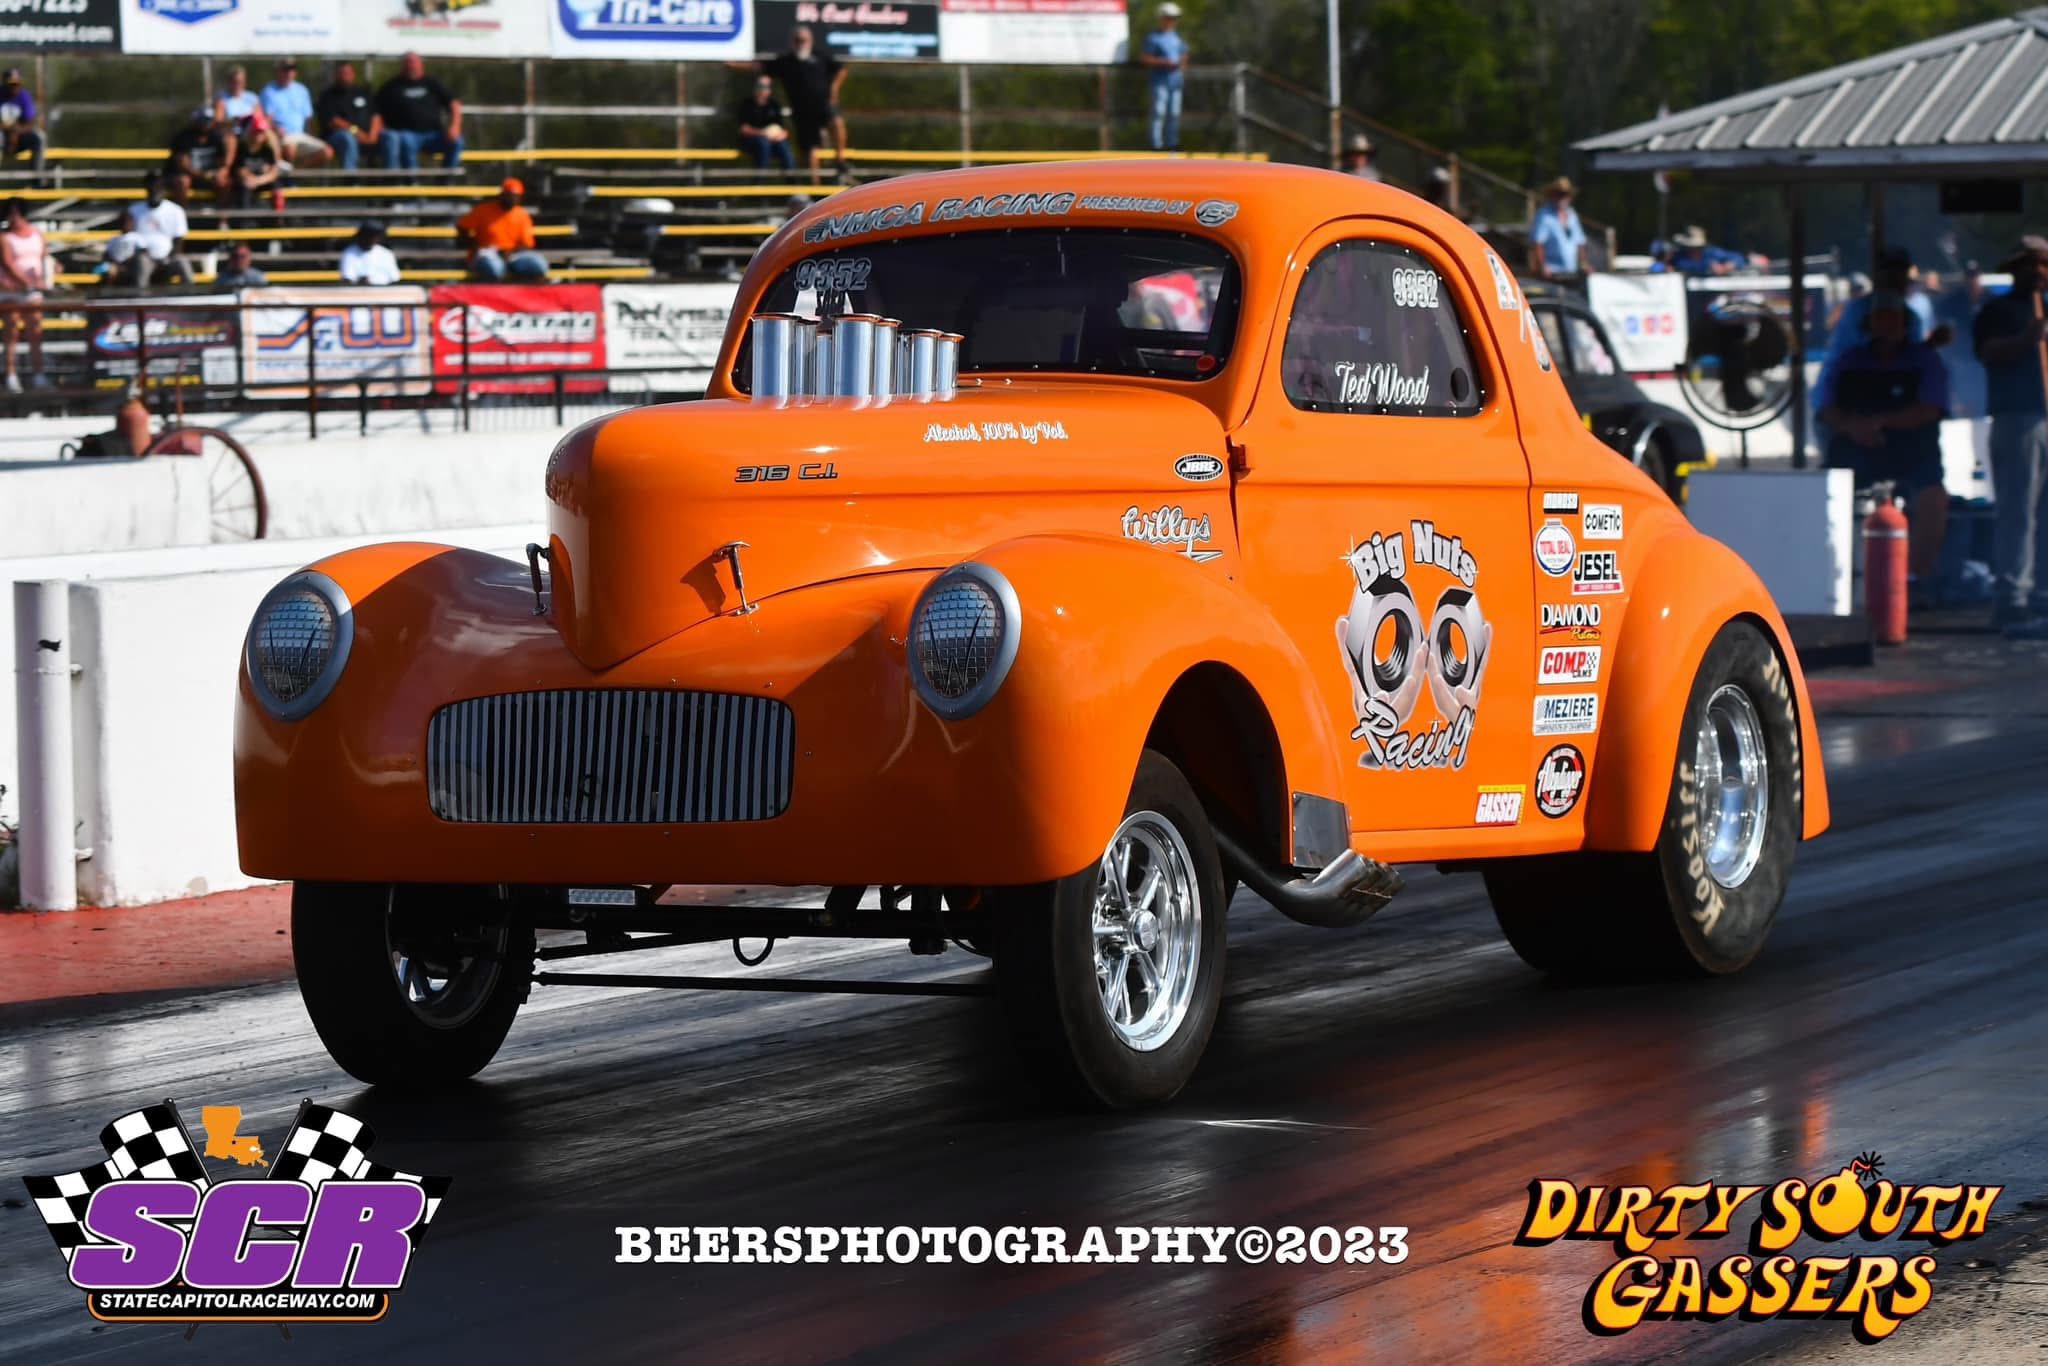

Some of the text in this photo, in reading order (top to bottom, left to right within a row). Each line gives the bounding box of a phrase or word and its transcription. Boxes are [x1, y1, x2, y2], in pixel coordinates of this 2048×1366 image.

[806, 202, 924, 242] NMCA
[929, 192, 1076, 222] RACING
[1076, 195, 1168, 213] PRESENTED
[1166, 200, 1194, 215] BY
[794, 257, 872, 292] 9352
[1392, 267, 1440, 308] 9352
[1335, 361, 1430, 406] Ted Wood
[981, 421, 1018, 440] 100%
[1018, 421, 1039, 444] by
[734, 463, 838, 483] 316 C.I.
[1181, 460, 1217, 473] JBRE
[1120, 505, 1215, 555] Willys
[1584, 510, 1622, 531] COMETIC
[1350, 519, 1479, 594] Big Nuts
[1574, 552, 1620, 581] JESEL
[1540, 603, 1601, 627] DIAMOND
[1543, 651, 1587, 674] COMP
[1572, 669, 1593, 679] CAMS
[1543, 697, 1595, 719] MEZIERE
[1351, 697, 1476, 770] Racing
[1475, 791, 1522, 824] GASSER
